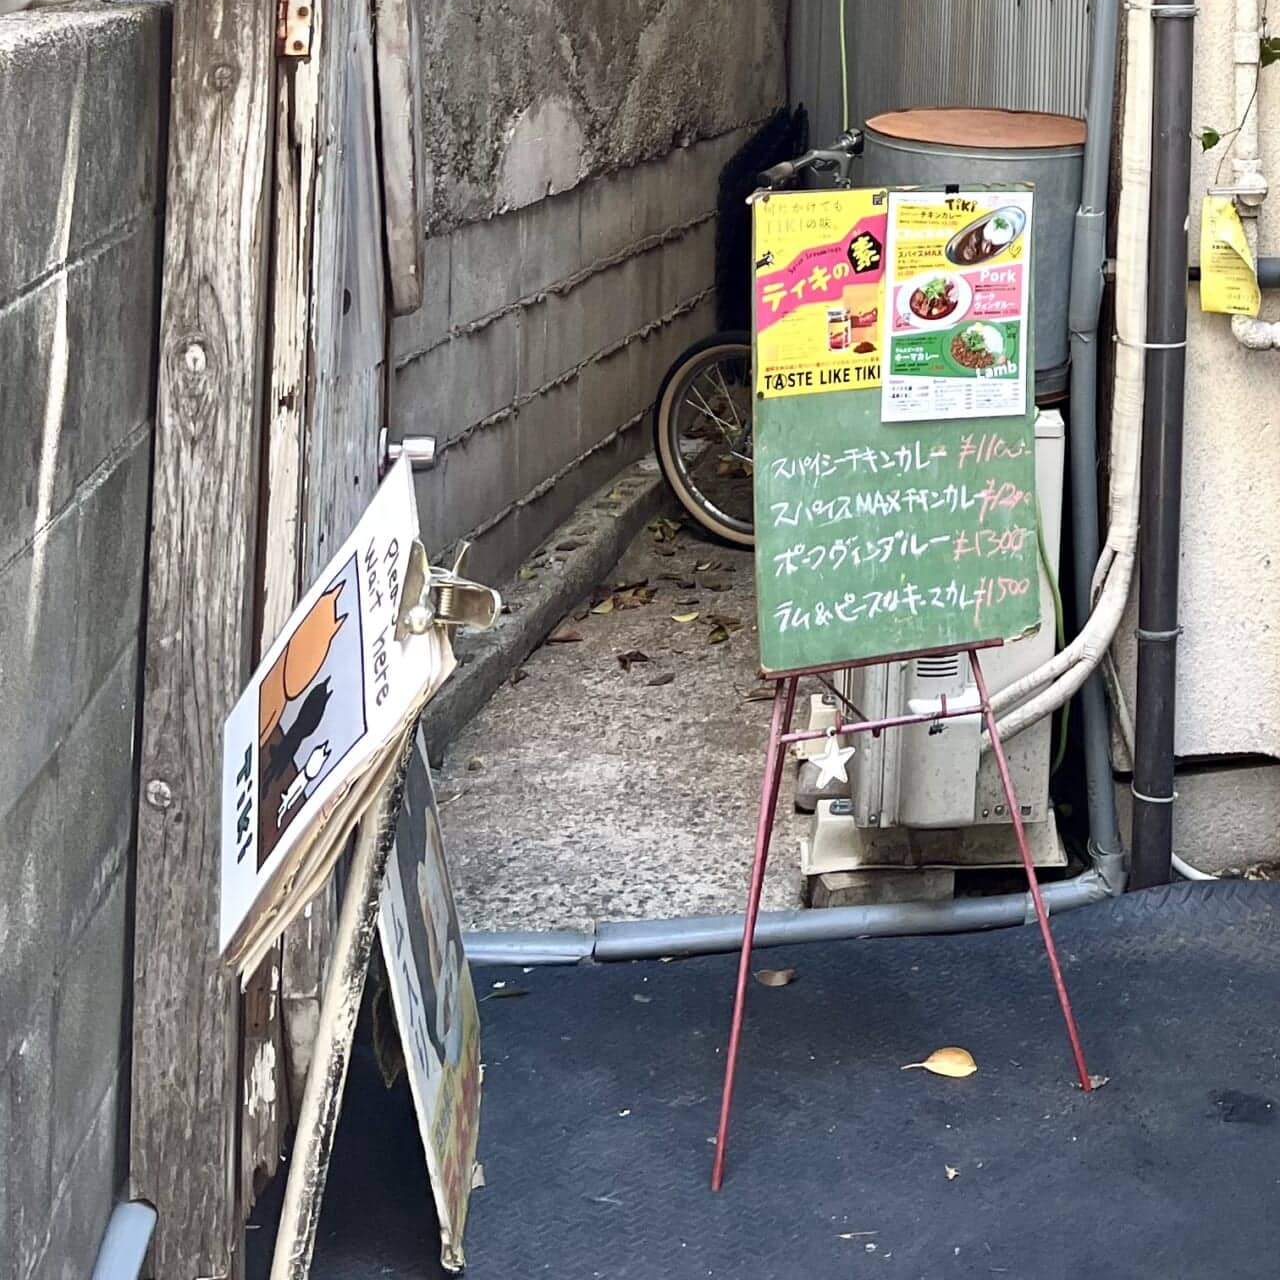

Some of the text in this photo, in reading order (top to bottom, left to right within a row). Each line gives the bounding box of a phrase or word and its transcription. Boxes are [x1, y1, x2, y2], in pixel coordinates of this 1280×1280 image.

[980, 269, 1017, 284] Pork
[764, 371, 813, 391] TASTE
[820, 367, 851, 385] LIKE
[855, 364, 881, 381] TIKI
[976, 360, 1018, 379] Lamb
[365, 536, 390, 707] wait here
